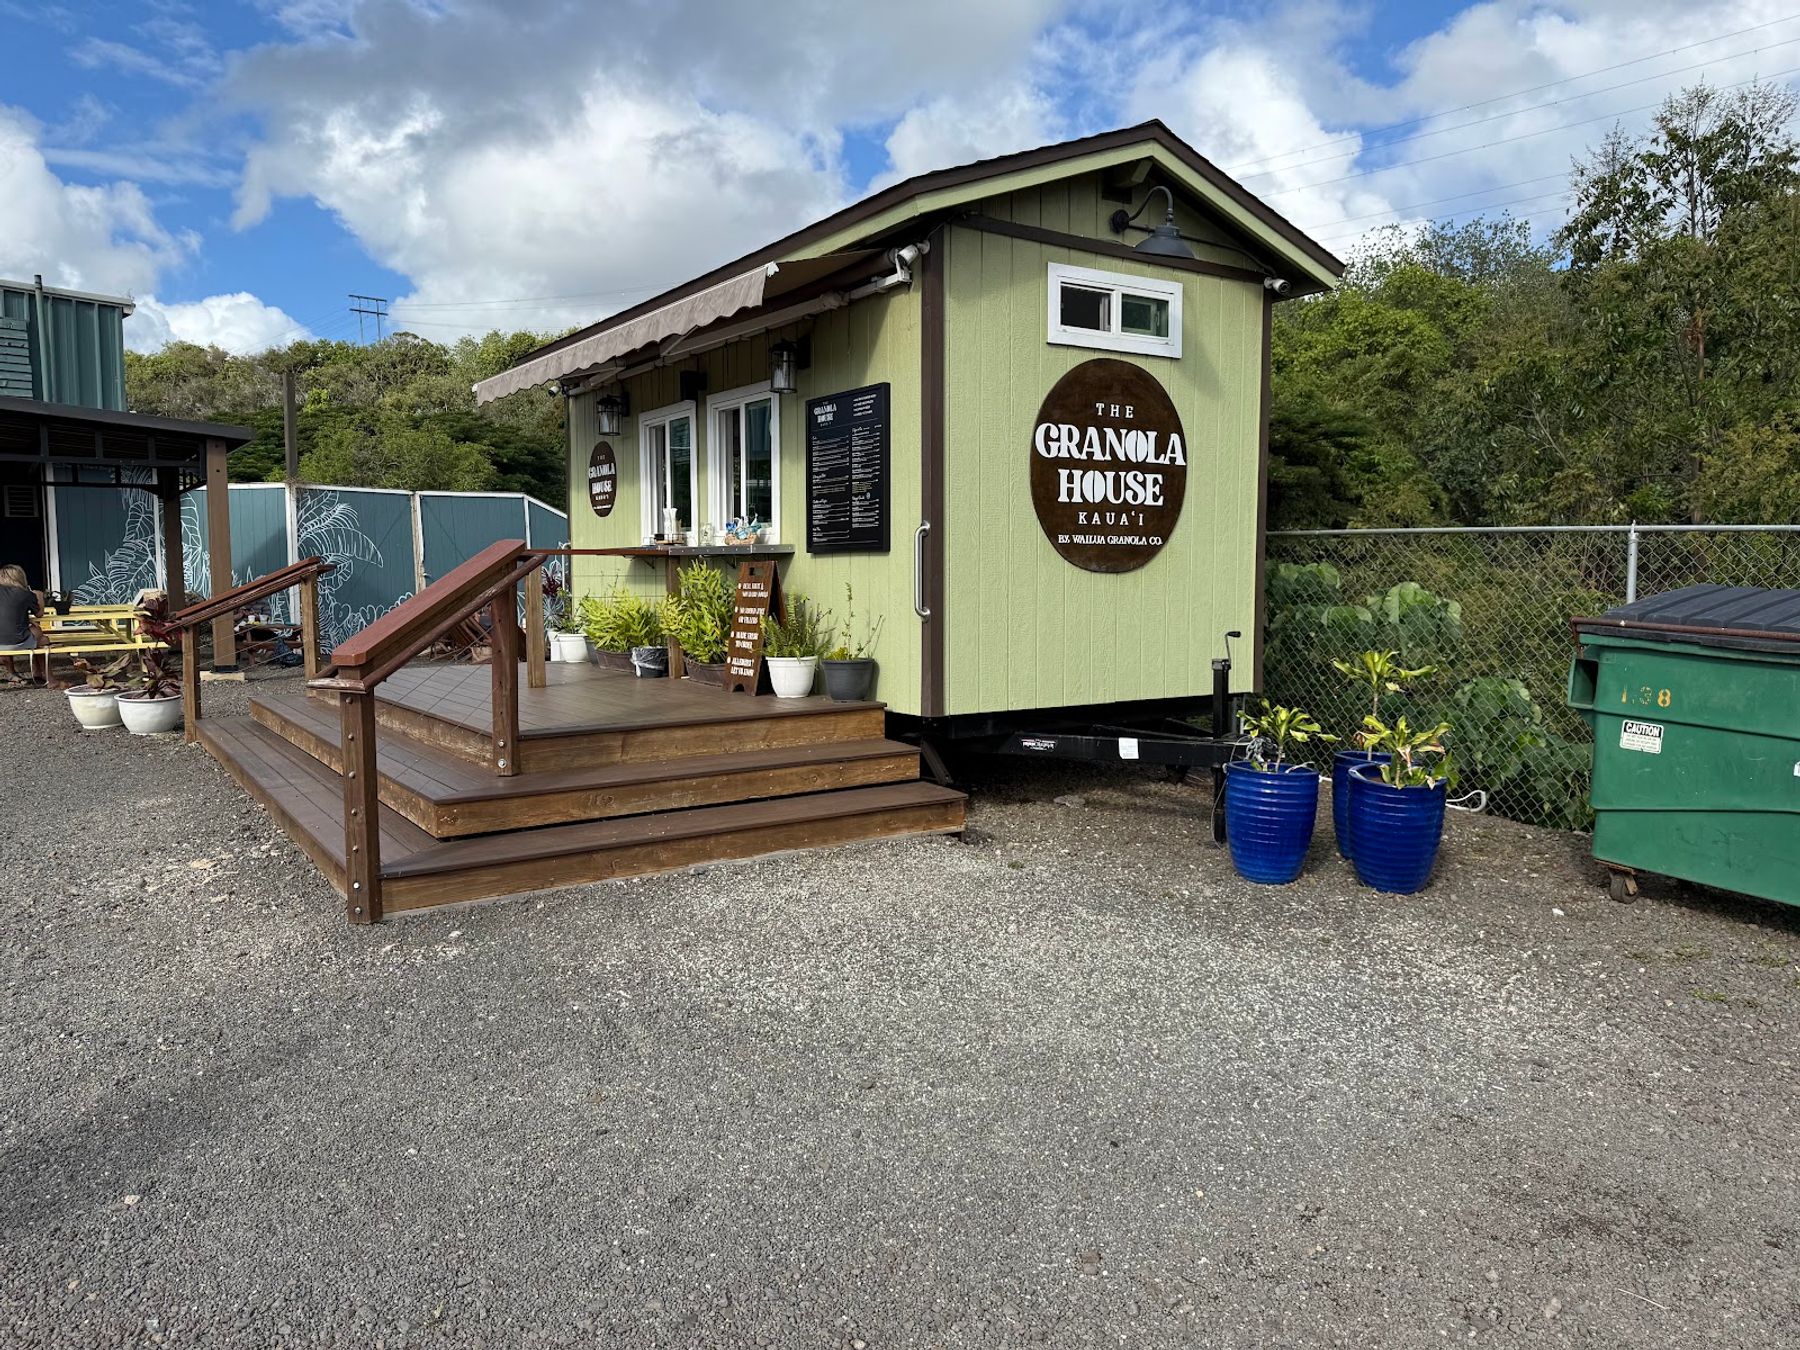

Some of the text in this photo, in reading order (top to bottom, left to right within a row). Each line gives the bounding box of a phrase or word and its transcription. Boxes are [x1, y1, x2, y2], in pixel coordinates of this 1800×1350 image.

[1096, 402, 1134, 419] THE
[1034, 422, 1187, 466] GRANOLA
[589, 463, 615, 479] GRANOLA
[592, 481, 613, 494] HOUSE
[1057, 468, 1164, 506] HOUSE
[1072, 534, 1106, 545] WAILUA
[1107, 535, 1148, 545] GRANOLA
[1626, 723, 1660, 736] CAUTION
